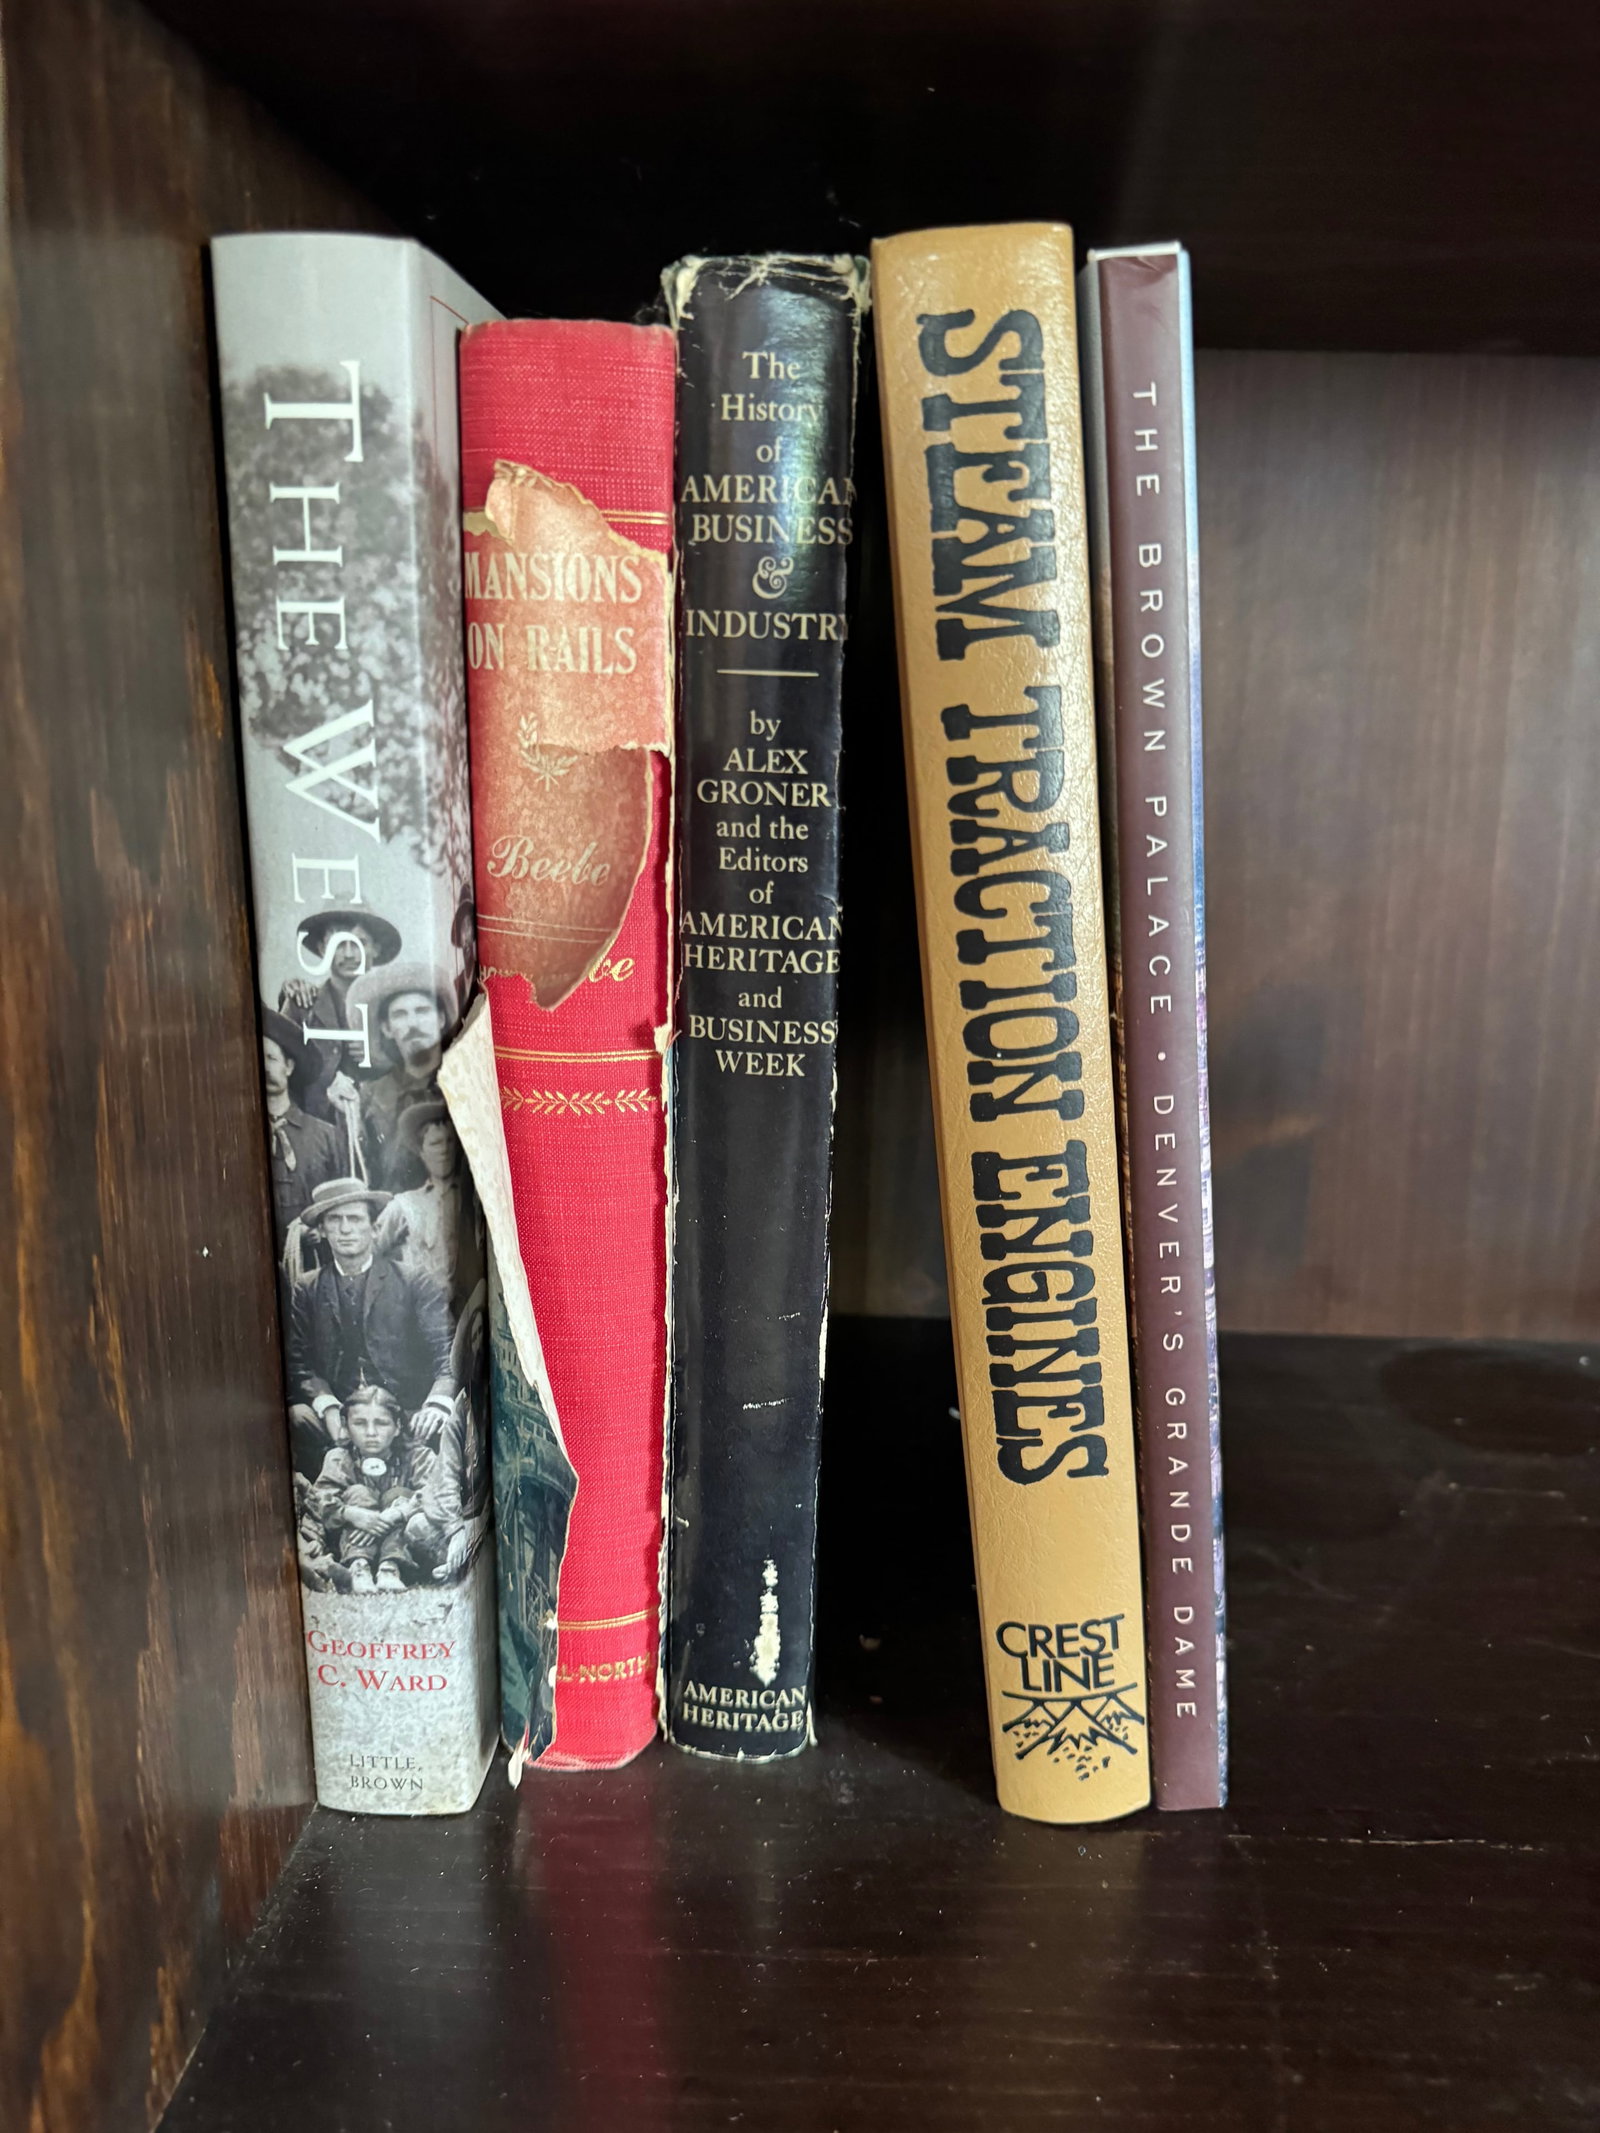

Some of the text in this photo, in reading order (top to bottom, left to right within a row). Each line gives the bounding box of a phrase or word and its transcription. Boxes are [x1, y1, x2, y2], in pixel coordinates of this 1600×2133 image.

[742, 351, 801, 380] The
[720, 393, 824, 427] History
[756, 436, 783, 464] of
[681, 475, 857, 506] AMERICAN
[692, 514, 853, 546] BUSINESS
[464, 551, 642, 604] MANSIONS
[752, 556, 794, 600] &
[467, 621, 637, 675] ON RAILS
[263, 359, 381, 1069] THE WEST
[750, 710, 781, 742] by
[723, 748, 808, 775] ALEX
[697, 780, 831, 808] GRONER
[716, 815, 809, 841] and the
[487, 834, 611, 887] Beebe
[719, 847, 809, 874] Editors
[748, 881, 774, 906] of
[916, 308, 1109, 1487] STEAM TRACTION ENGINES
[679, 911, 842, 941] AMERICAN
[684, 944, 840, 975] HERITAGE
[738, 986, 782, 1009] and
[689, 1015, 836, 1045] BUSINESS
[715, 1050, 806, 1077] WEEK
[1133, 381, 1197, 1718] THE BROWN PALACE DENVER'S GRANDE DAME
[306, 1630, 456, 1660] GEOFFREY
[996, 1613, 1125, 1659] CREST
[317, 1664, 448, 1691] C. WARD
[1020, 1651, 1115, 1693] LINE
[683, 1680, 807, 1710] AMERICAN
[682, 1702, 805, 1734] HERITAGE
[350, 1753, 424, 1772] LITTLE,
[350, 1775, 424, 1791] BROWN
